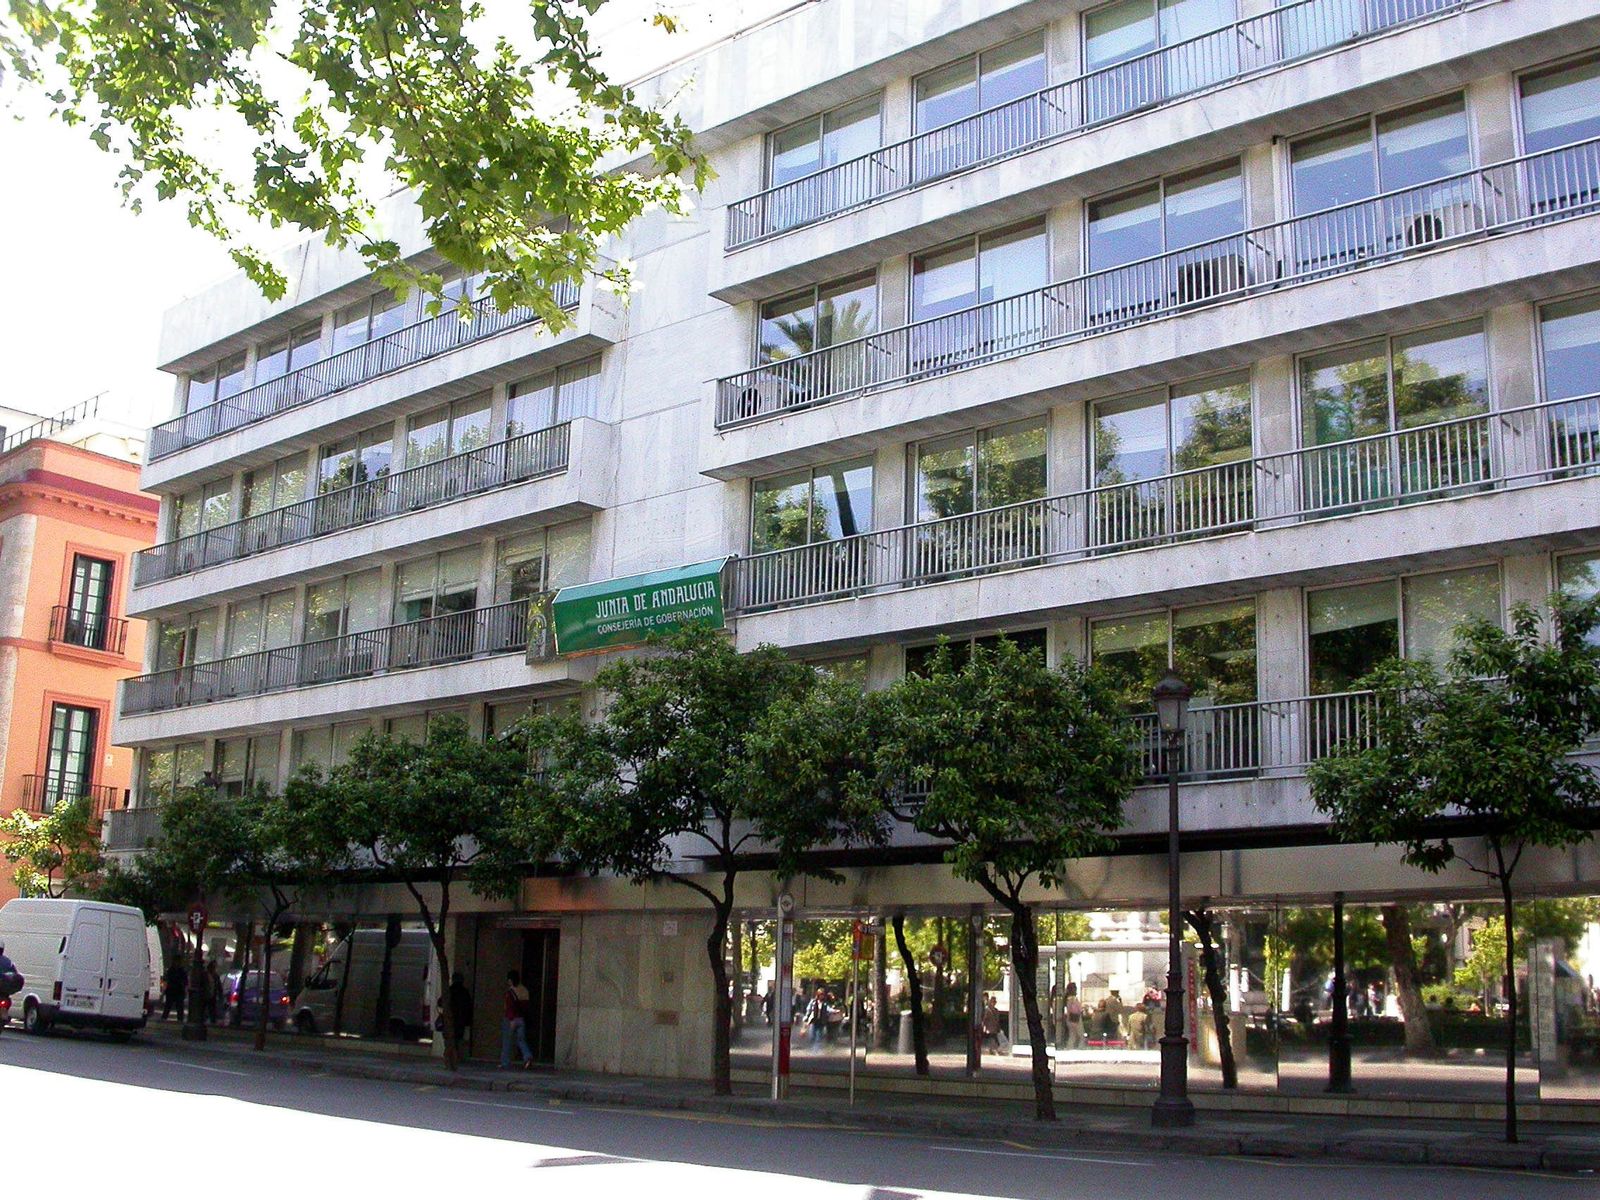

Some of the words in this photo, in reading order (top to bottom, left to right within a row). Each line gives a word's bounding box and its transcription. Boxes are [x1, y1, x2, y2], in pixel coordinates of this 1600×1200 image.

[595, 596, 629, 619] JUNTA
[633, 593, 648, 611] DE
[652, 580, 716, 608] ANDALUCIA
[597, 615, 643, 634] CONSEJERÍA
[643, 616, 655, 627] DE
[655, 603, 714, 624] GOBERNACIÓN
